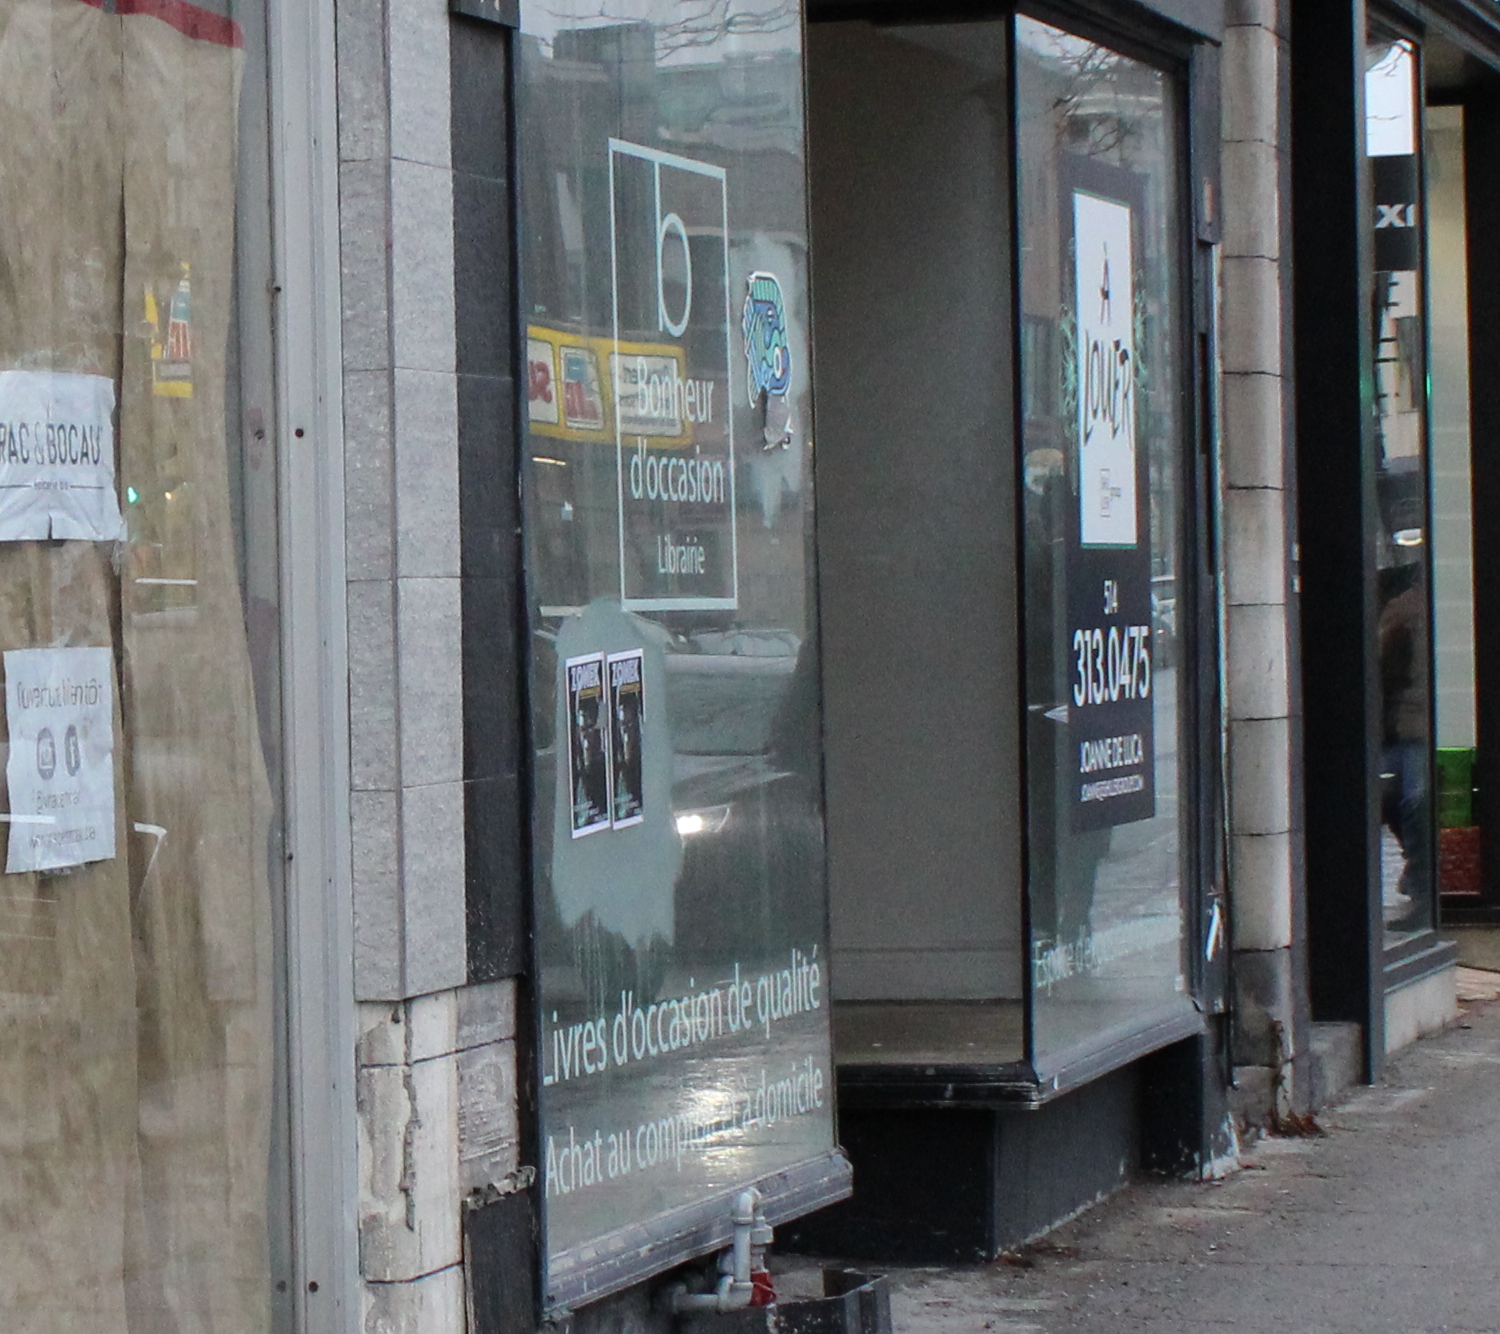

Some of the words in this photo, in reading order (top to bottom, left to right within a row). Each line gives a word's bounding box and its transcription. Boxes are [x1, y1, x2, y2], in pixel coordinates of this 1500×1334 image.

[1099, 241, 1111, 326] À
[636, 355, 715, 423] Bonheur
[1083, 329, 1135, 452] LOUER
[34, 421, 45, 465] &
[46, 423, 102, 465] BOCAU
[629, 436, 725, 504] d'occasion
[657, 533, 706, 575] Librairie
[1073, 625, 1150, 707] 313.0475
[613, 976, 723, 1067] d'occasion
[727, 961, 752, 1034] de
[756, 943, 821, 1040] qualité
[544, 1126, 604, 1199] Achat
[607, 1129, 631, 1180] au
[754, 1053, 824, 1128] domicile
